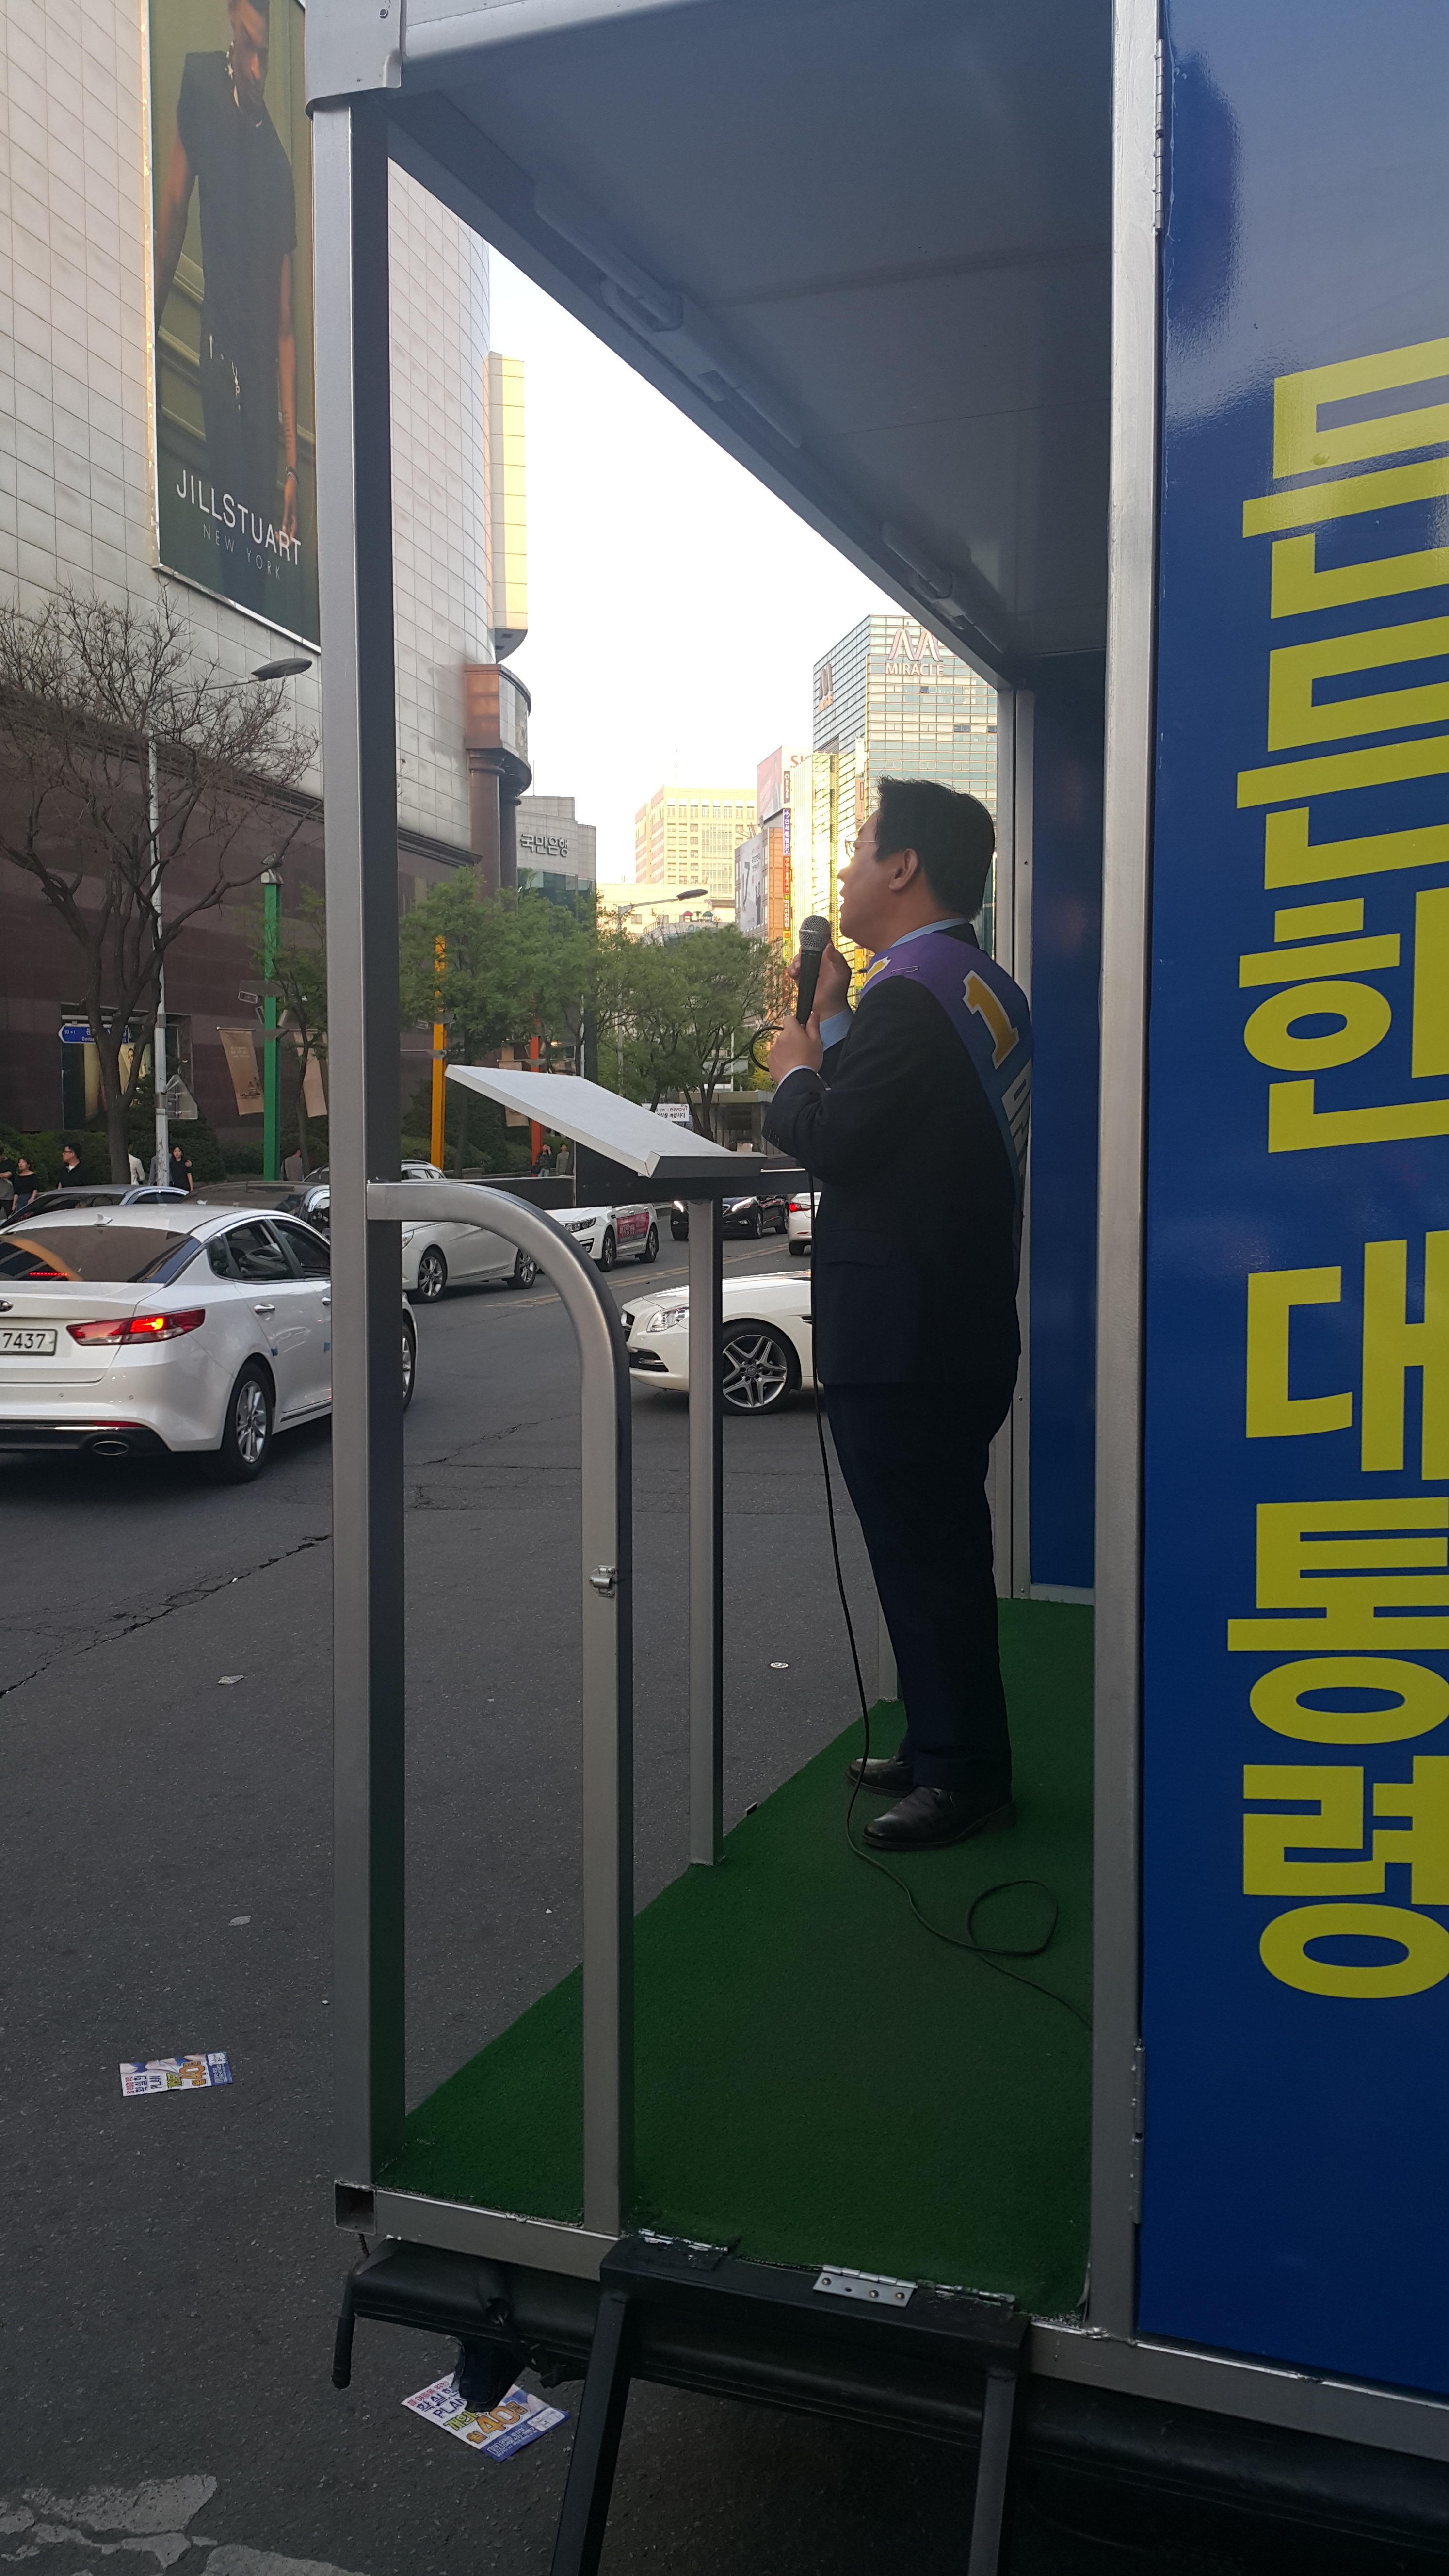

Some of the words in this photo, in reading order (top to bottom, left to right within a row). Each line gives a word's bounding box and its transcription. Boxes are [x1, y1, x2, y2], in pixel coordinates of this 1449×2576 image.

[203, 523, 234, 553] NEW
[246, 548, 280, 580] YORK
[886, 663, 944, 676] MIRACLE
[520, 834, 569, 857] 국민은행
[962, 969, 1019, 1070] 1
[2, 1333, 46, 1349] 7437
[1227, 1229, 1449, 2000] 대통령
[149, 2075, 162, 2089] PLAN
[476, 2406, 520, 2434] 40
